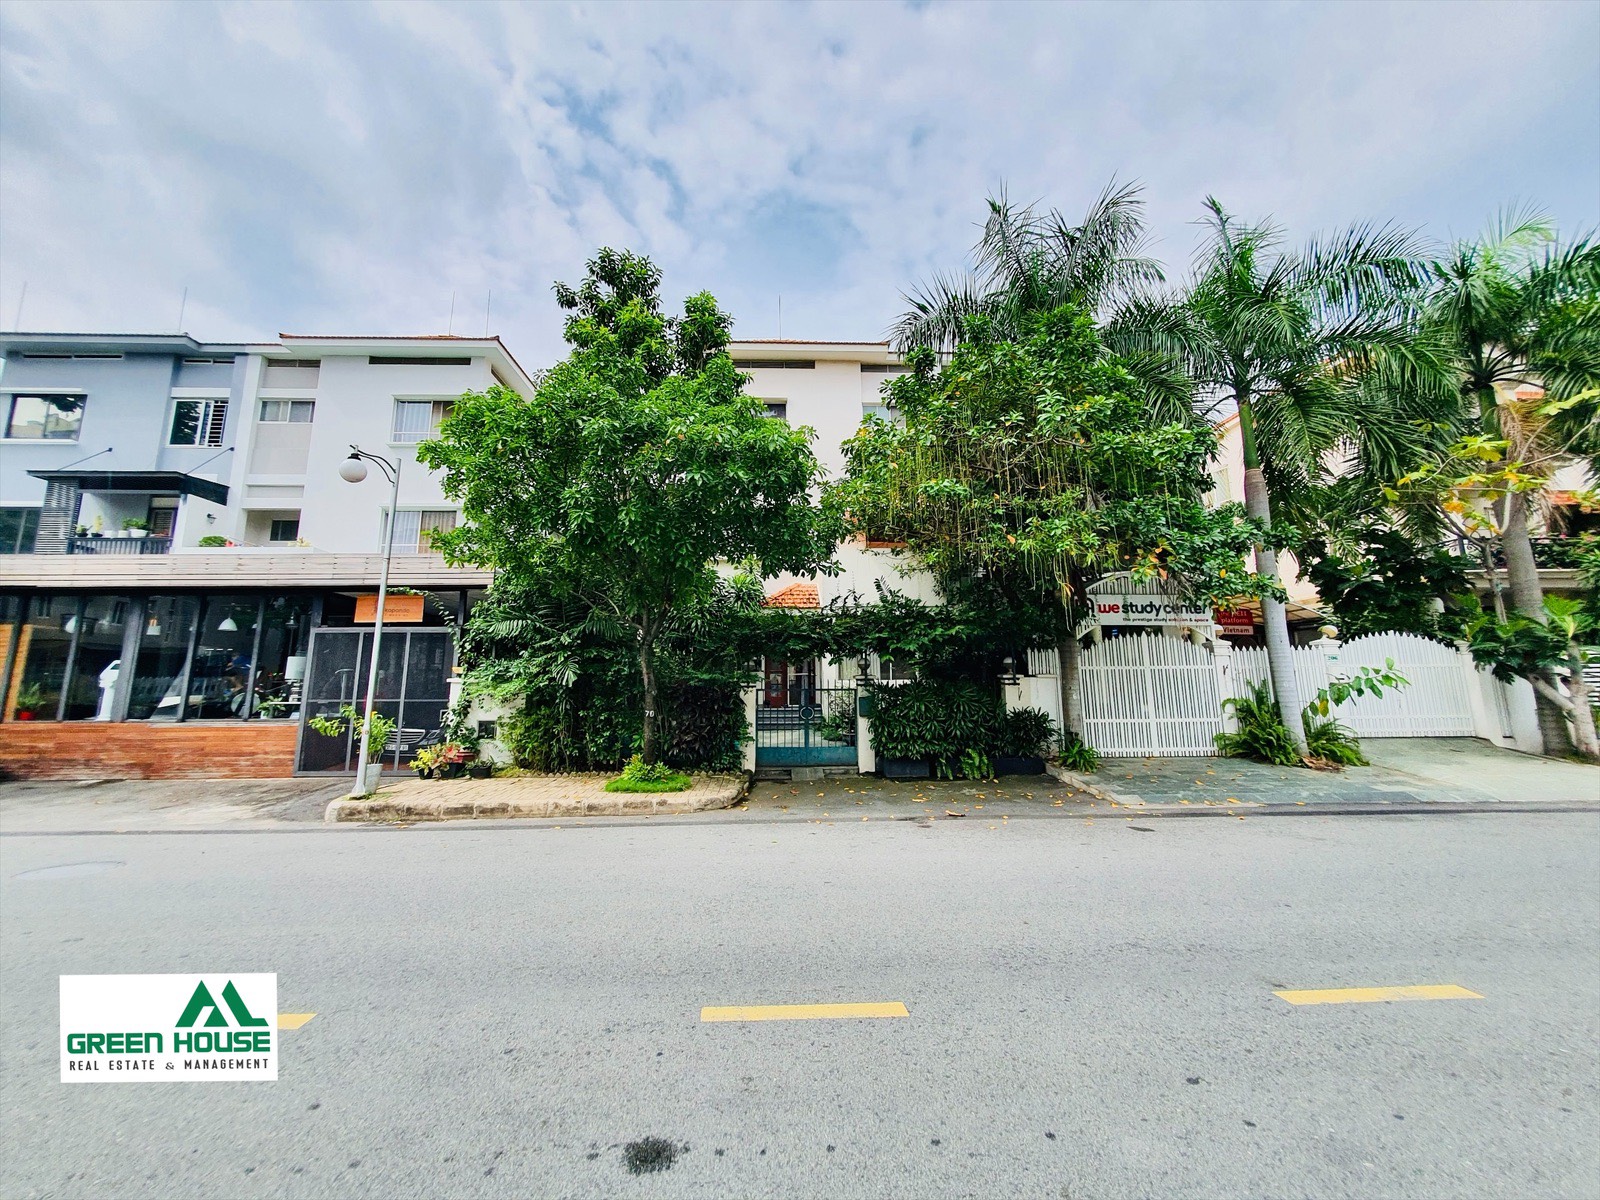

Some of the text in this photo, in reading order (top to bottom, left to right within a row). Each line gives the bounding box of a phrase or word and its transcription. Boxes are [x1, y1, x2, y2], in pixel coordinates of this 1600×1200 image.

[1097, 604, 1120, 614] we
[1122, 601, 1161, 617] study
[1163, 603, 1207, 614] center
[645, 710, 655, 718] 70
